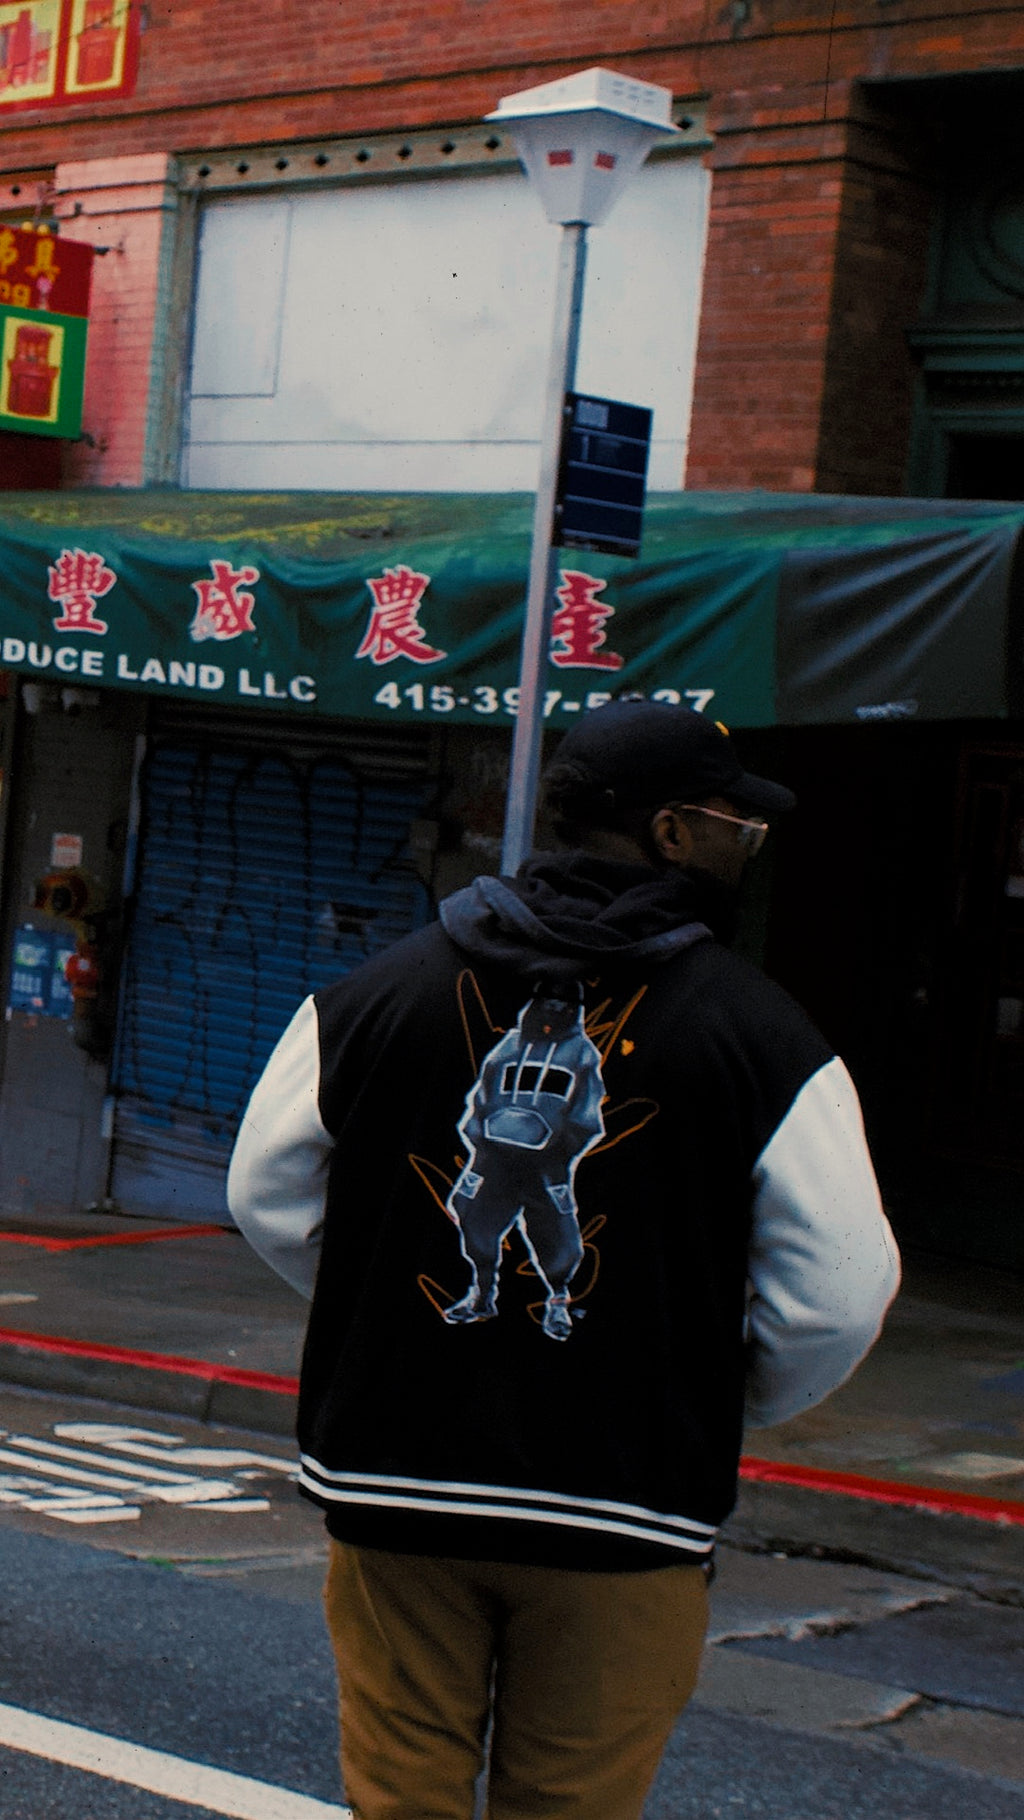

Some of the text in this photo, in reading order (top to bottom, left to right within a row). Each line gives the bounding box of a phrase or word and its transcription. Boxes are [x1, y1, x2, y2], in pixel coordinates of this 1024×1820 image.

[0, 637, 317, 702] DUCE LAND LLC
